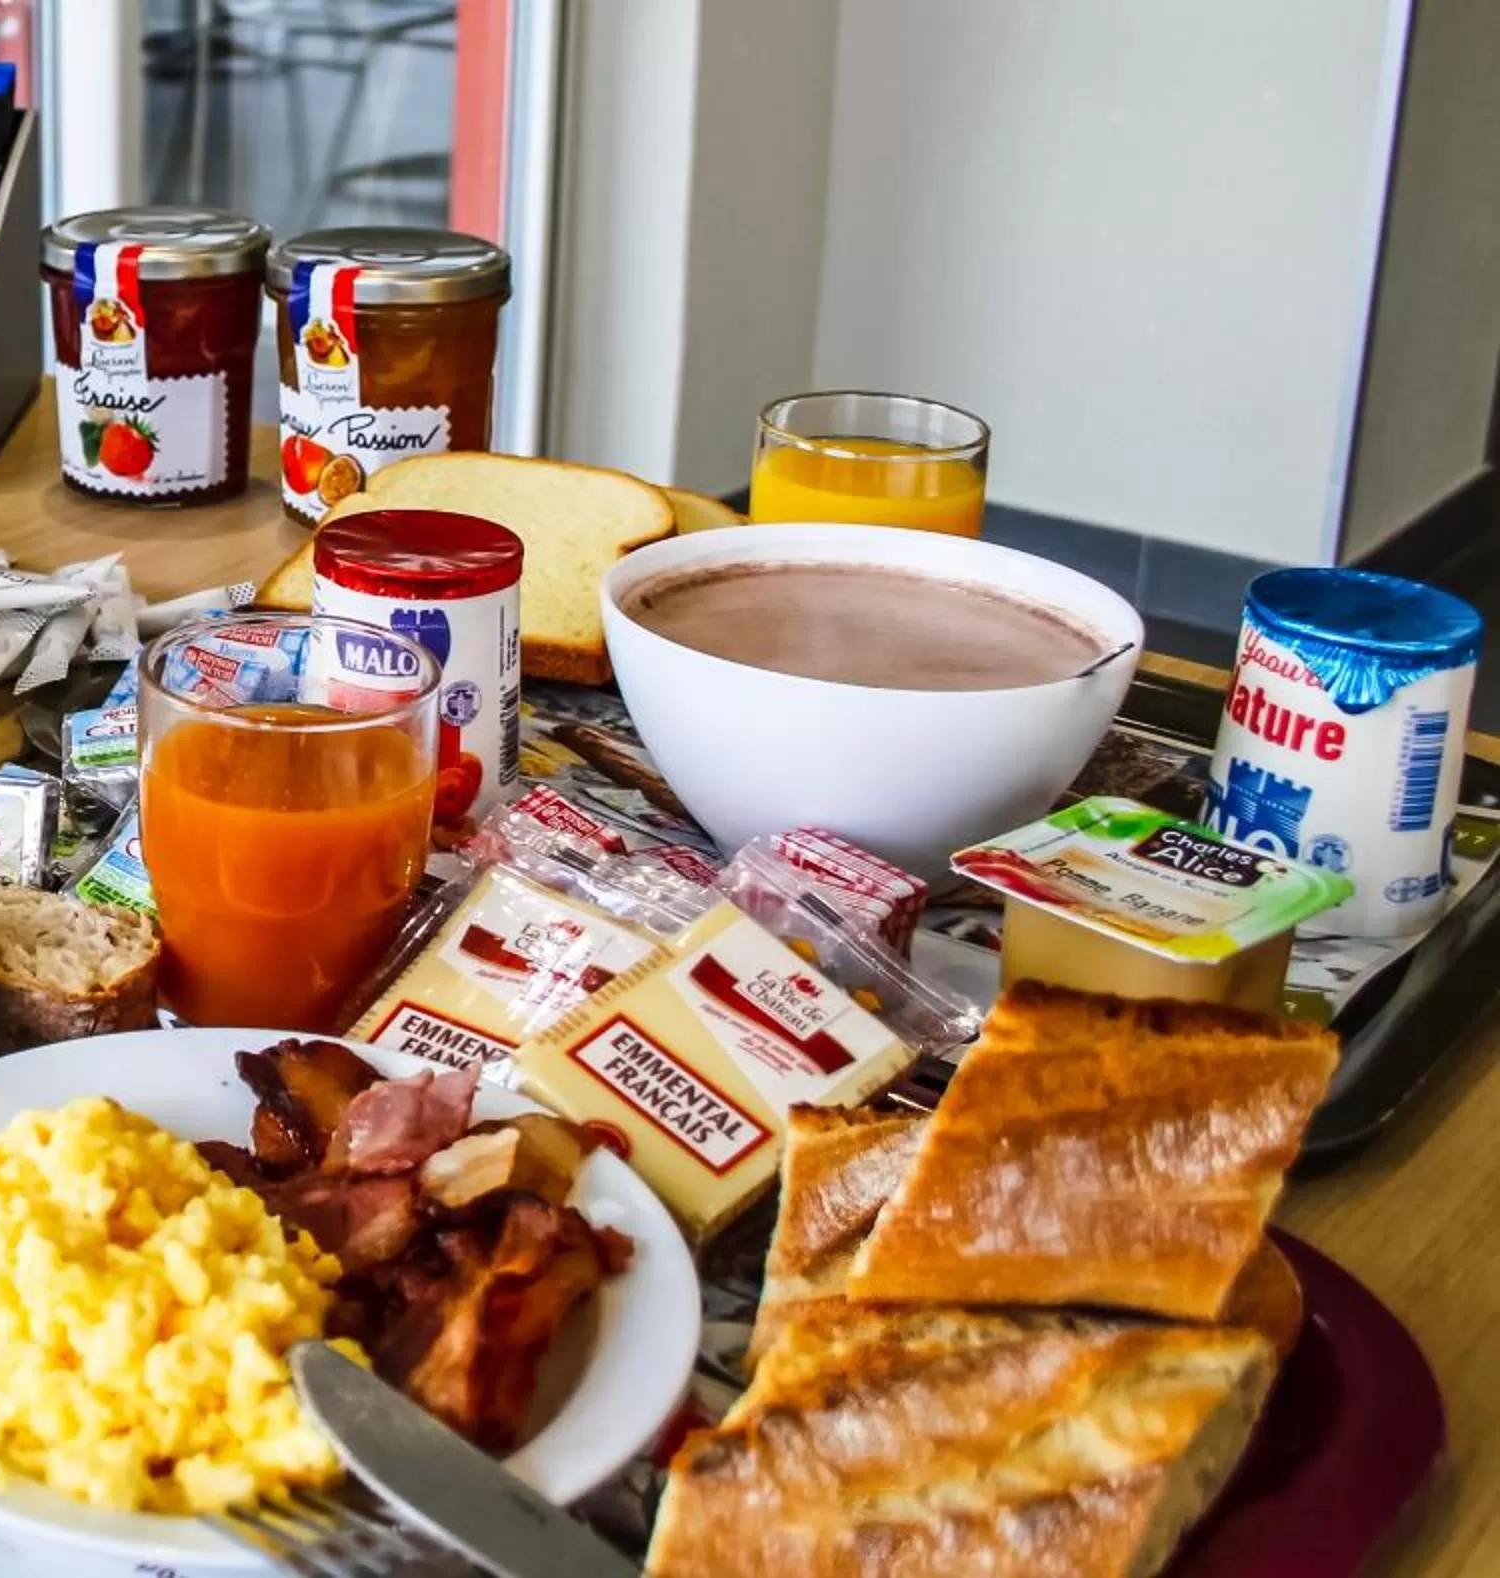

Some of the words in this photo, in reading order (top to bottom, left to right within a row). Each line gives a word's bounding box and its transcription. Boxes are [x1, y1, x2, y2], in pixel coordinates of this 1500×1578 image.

[327, 413, 441, 451] Passion
[344, 641, 419, 676] MALO
[1147, 846, 1244, 883] Alice
[1160, 830, 1254, 866] Charles
[1041, 857, 1112, 893] Pomme
[1120, 892, 1206, 926] Banane
[603, 1057, 715, 1144] FRANÇAIS
[611, 1031, 744, 1142] EMMENTAL
